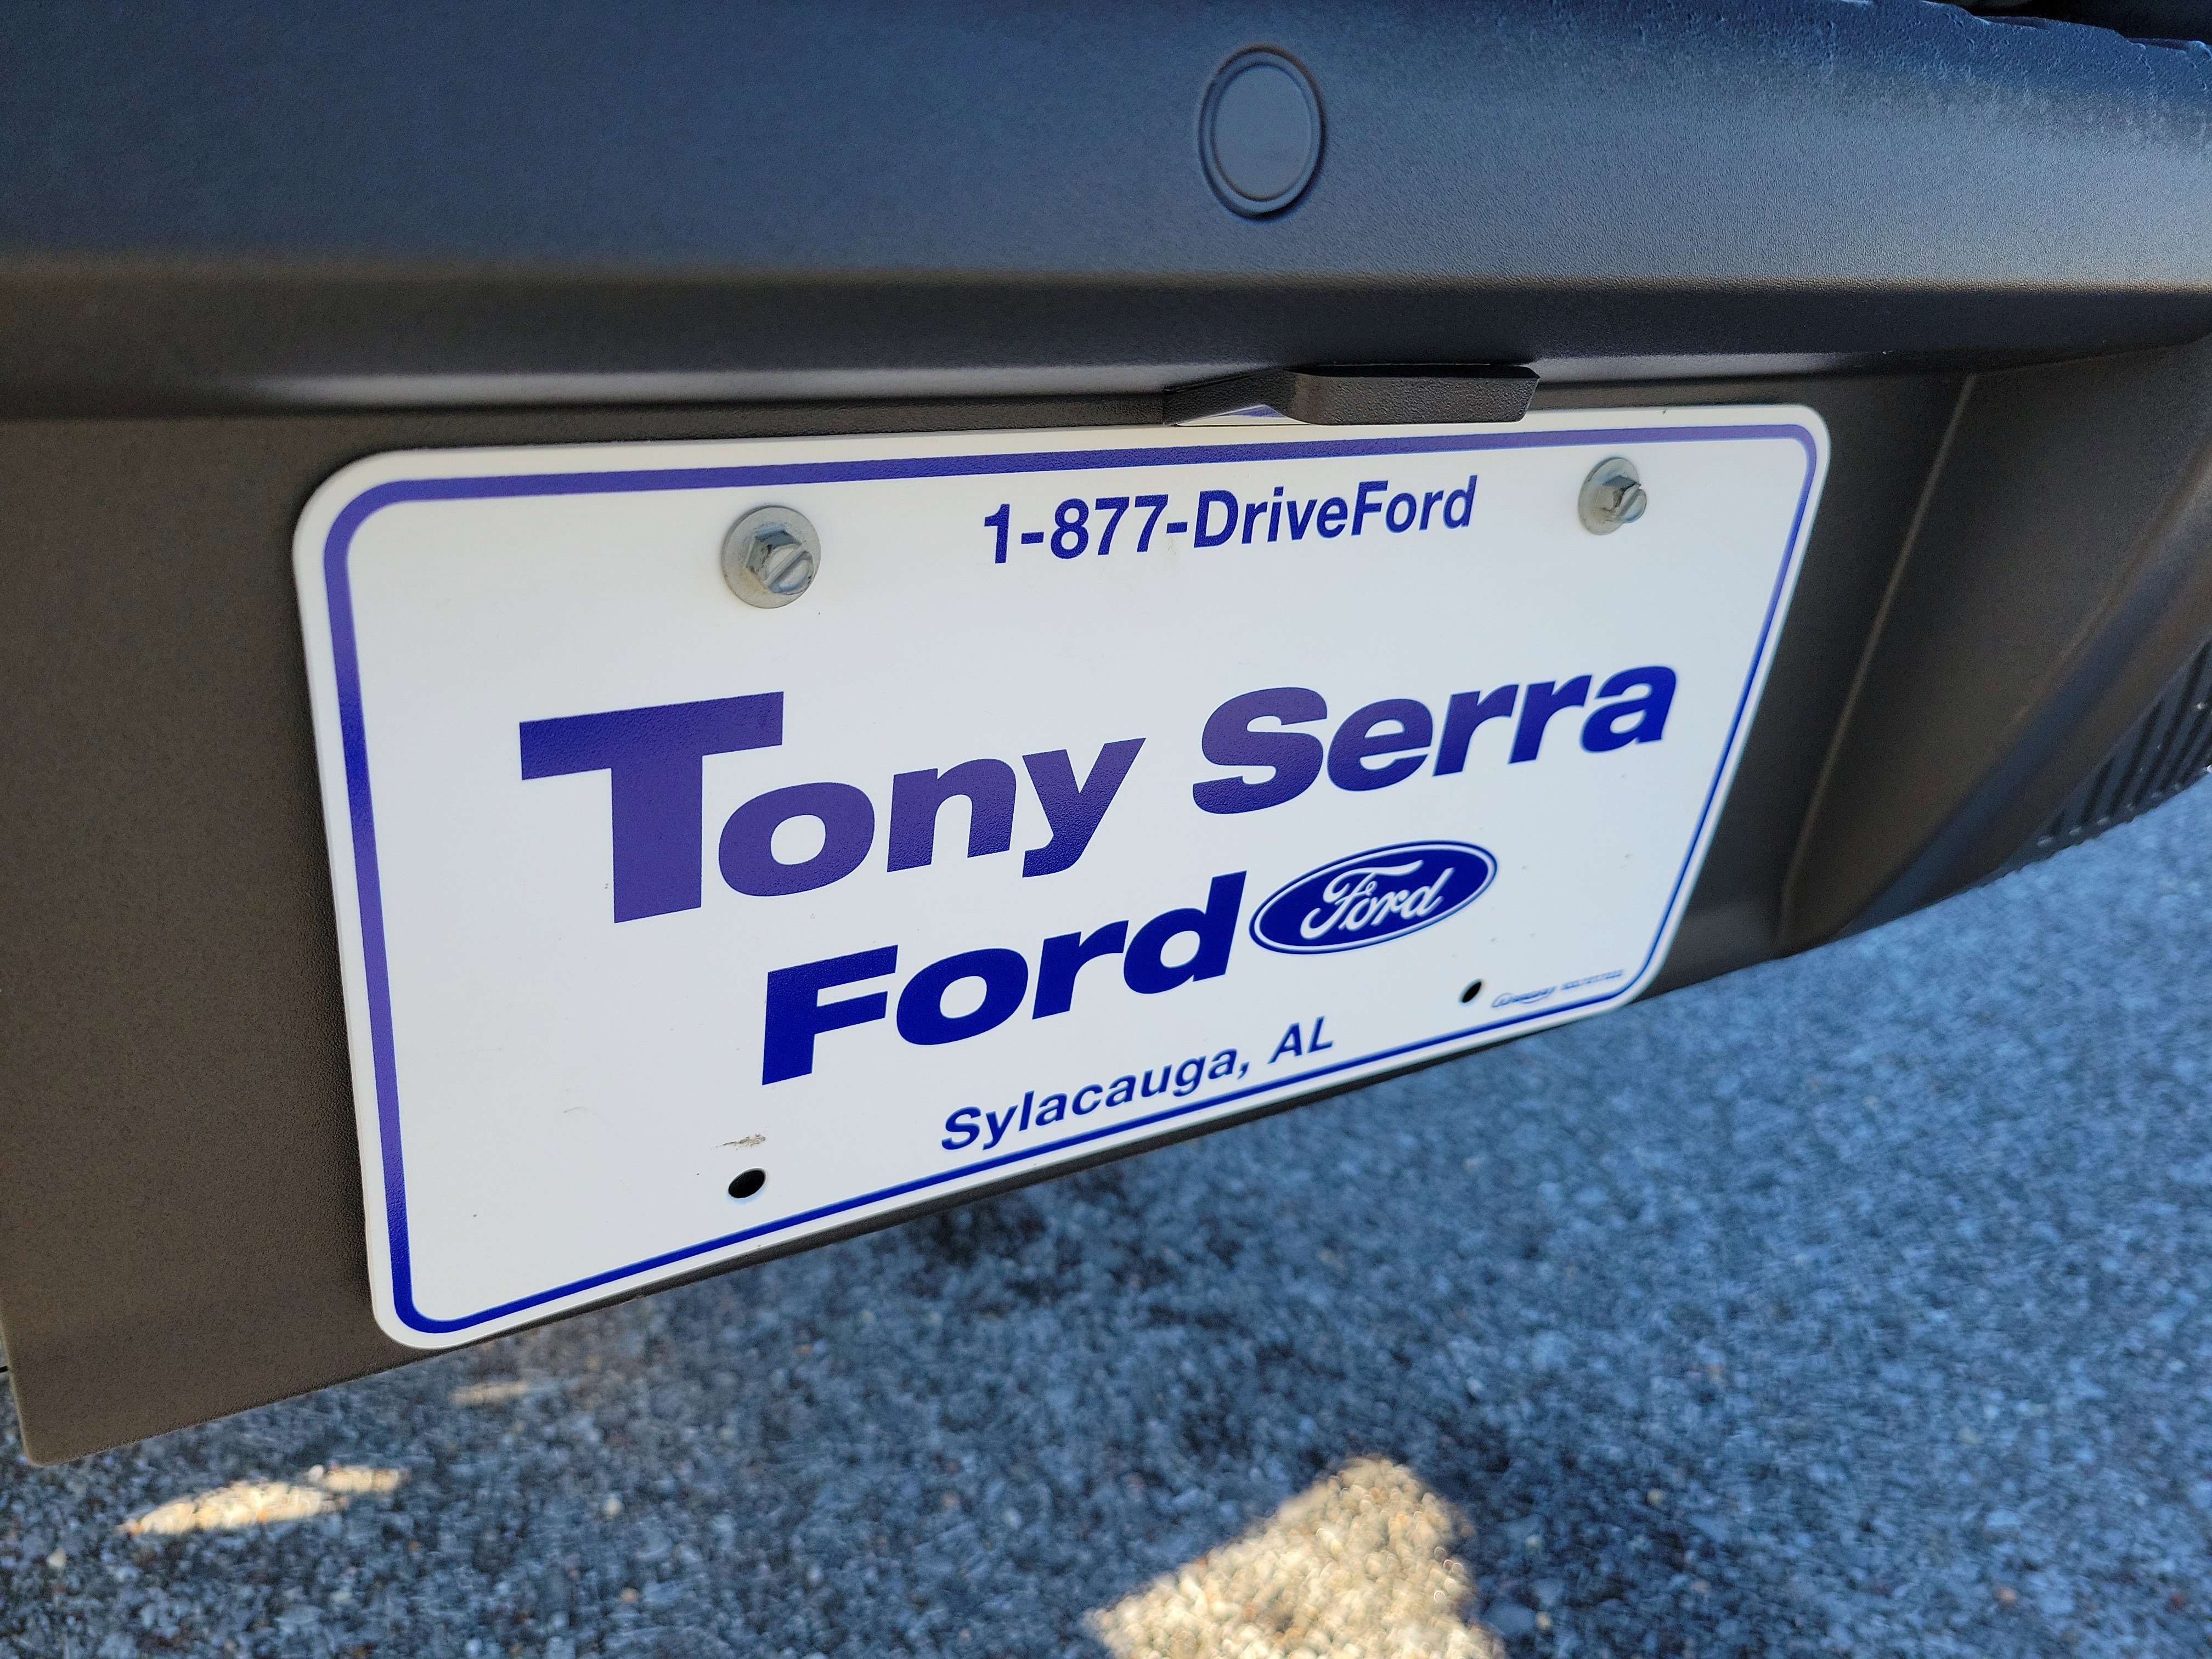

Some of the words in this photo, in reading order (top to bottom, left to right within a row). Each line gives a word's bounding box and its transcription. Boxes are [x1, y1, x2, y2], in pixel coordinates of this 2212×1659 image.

[983, 474, 1479, 565] 1-877-DriveFord
[518, 690, 1147, 924] Tony
[1192, 664, 1678, 816] Serra
[1300, 859, 1455, 940] Ford
[761, 869, 1248, 1086] Ford
[940, 1048, 1250, 1152] Sylacauga,
[1267, 1015, 1334, 1065] AL
